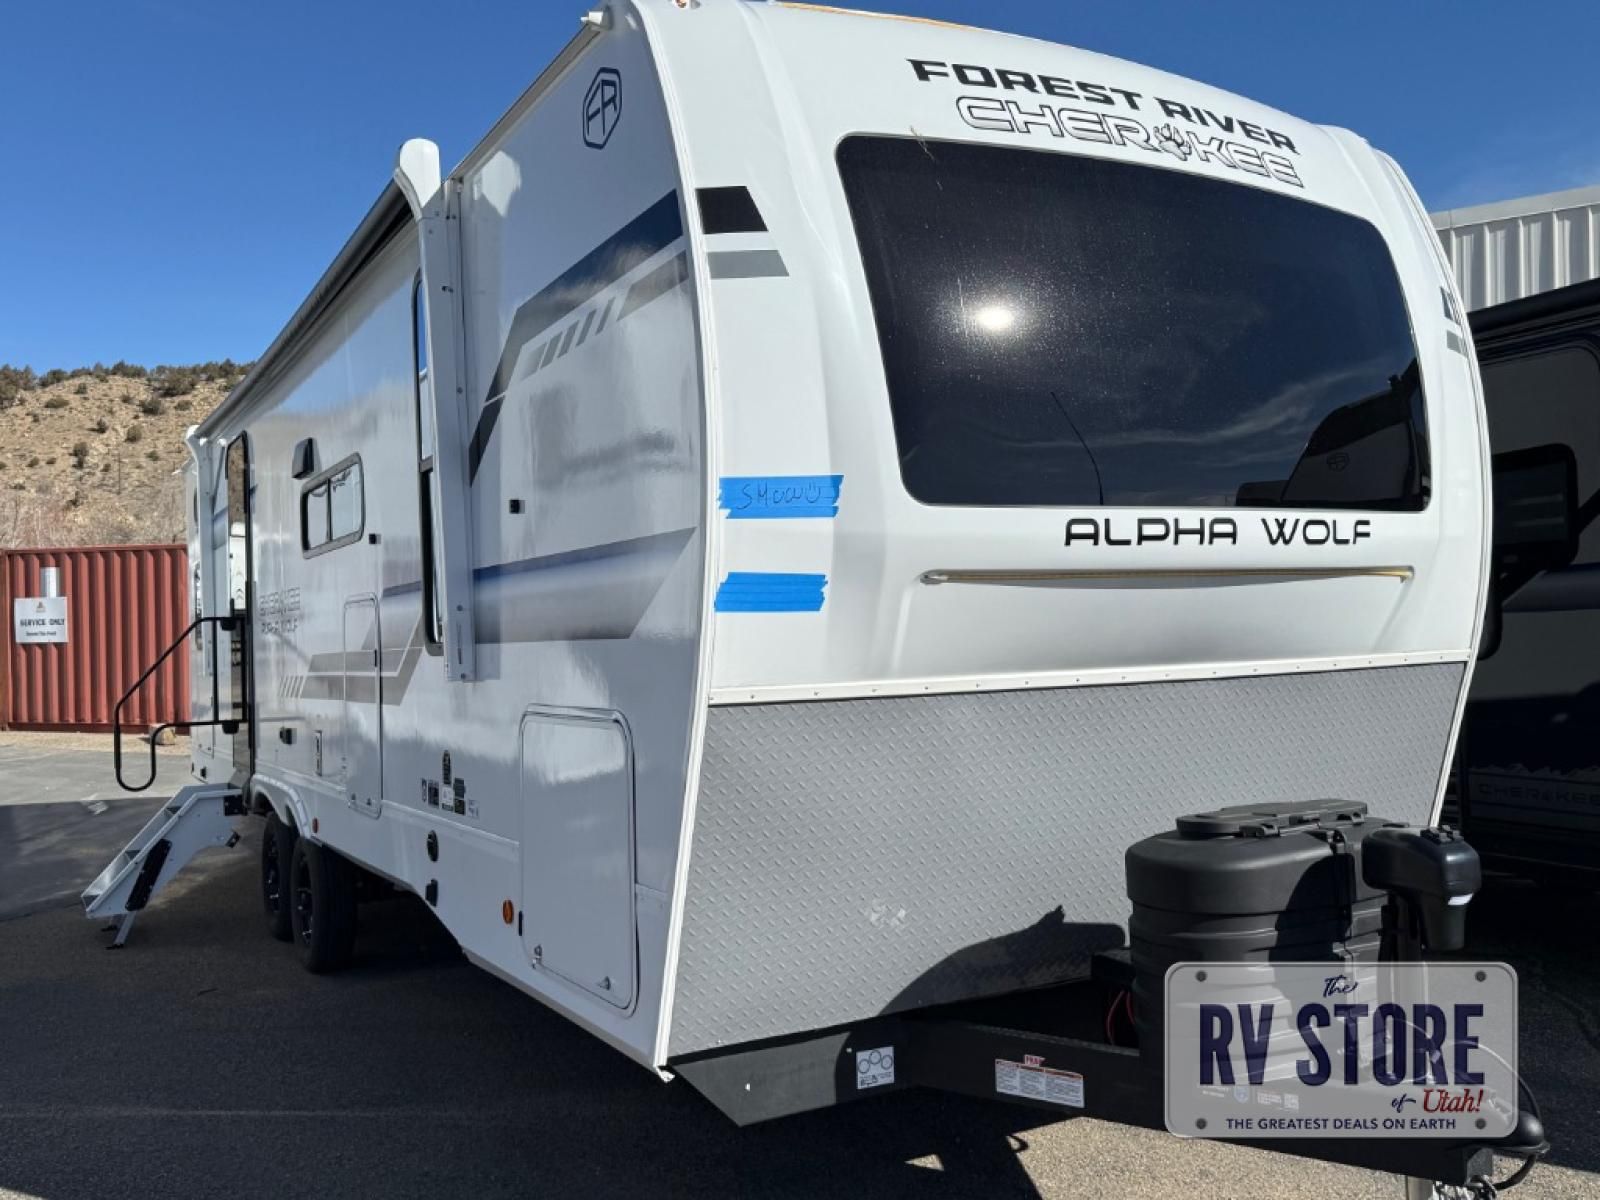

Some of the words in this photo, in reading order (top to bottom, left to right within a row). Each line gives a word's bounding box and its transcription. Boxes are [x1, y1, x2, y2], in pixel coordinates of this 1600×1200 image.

[907, 58, 1143, 110] FOREST
[1154, 97, 1300, 154] RIVER
[1064, 517, 1238, 546] ALPHA
[1260, 518, 1371, 545] WOLF
